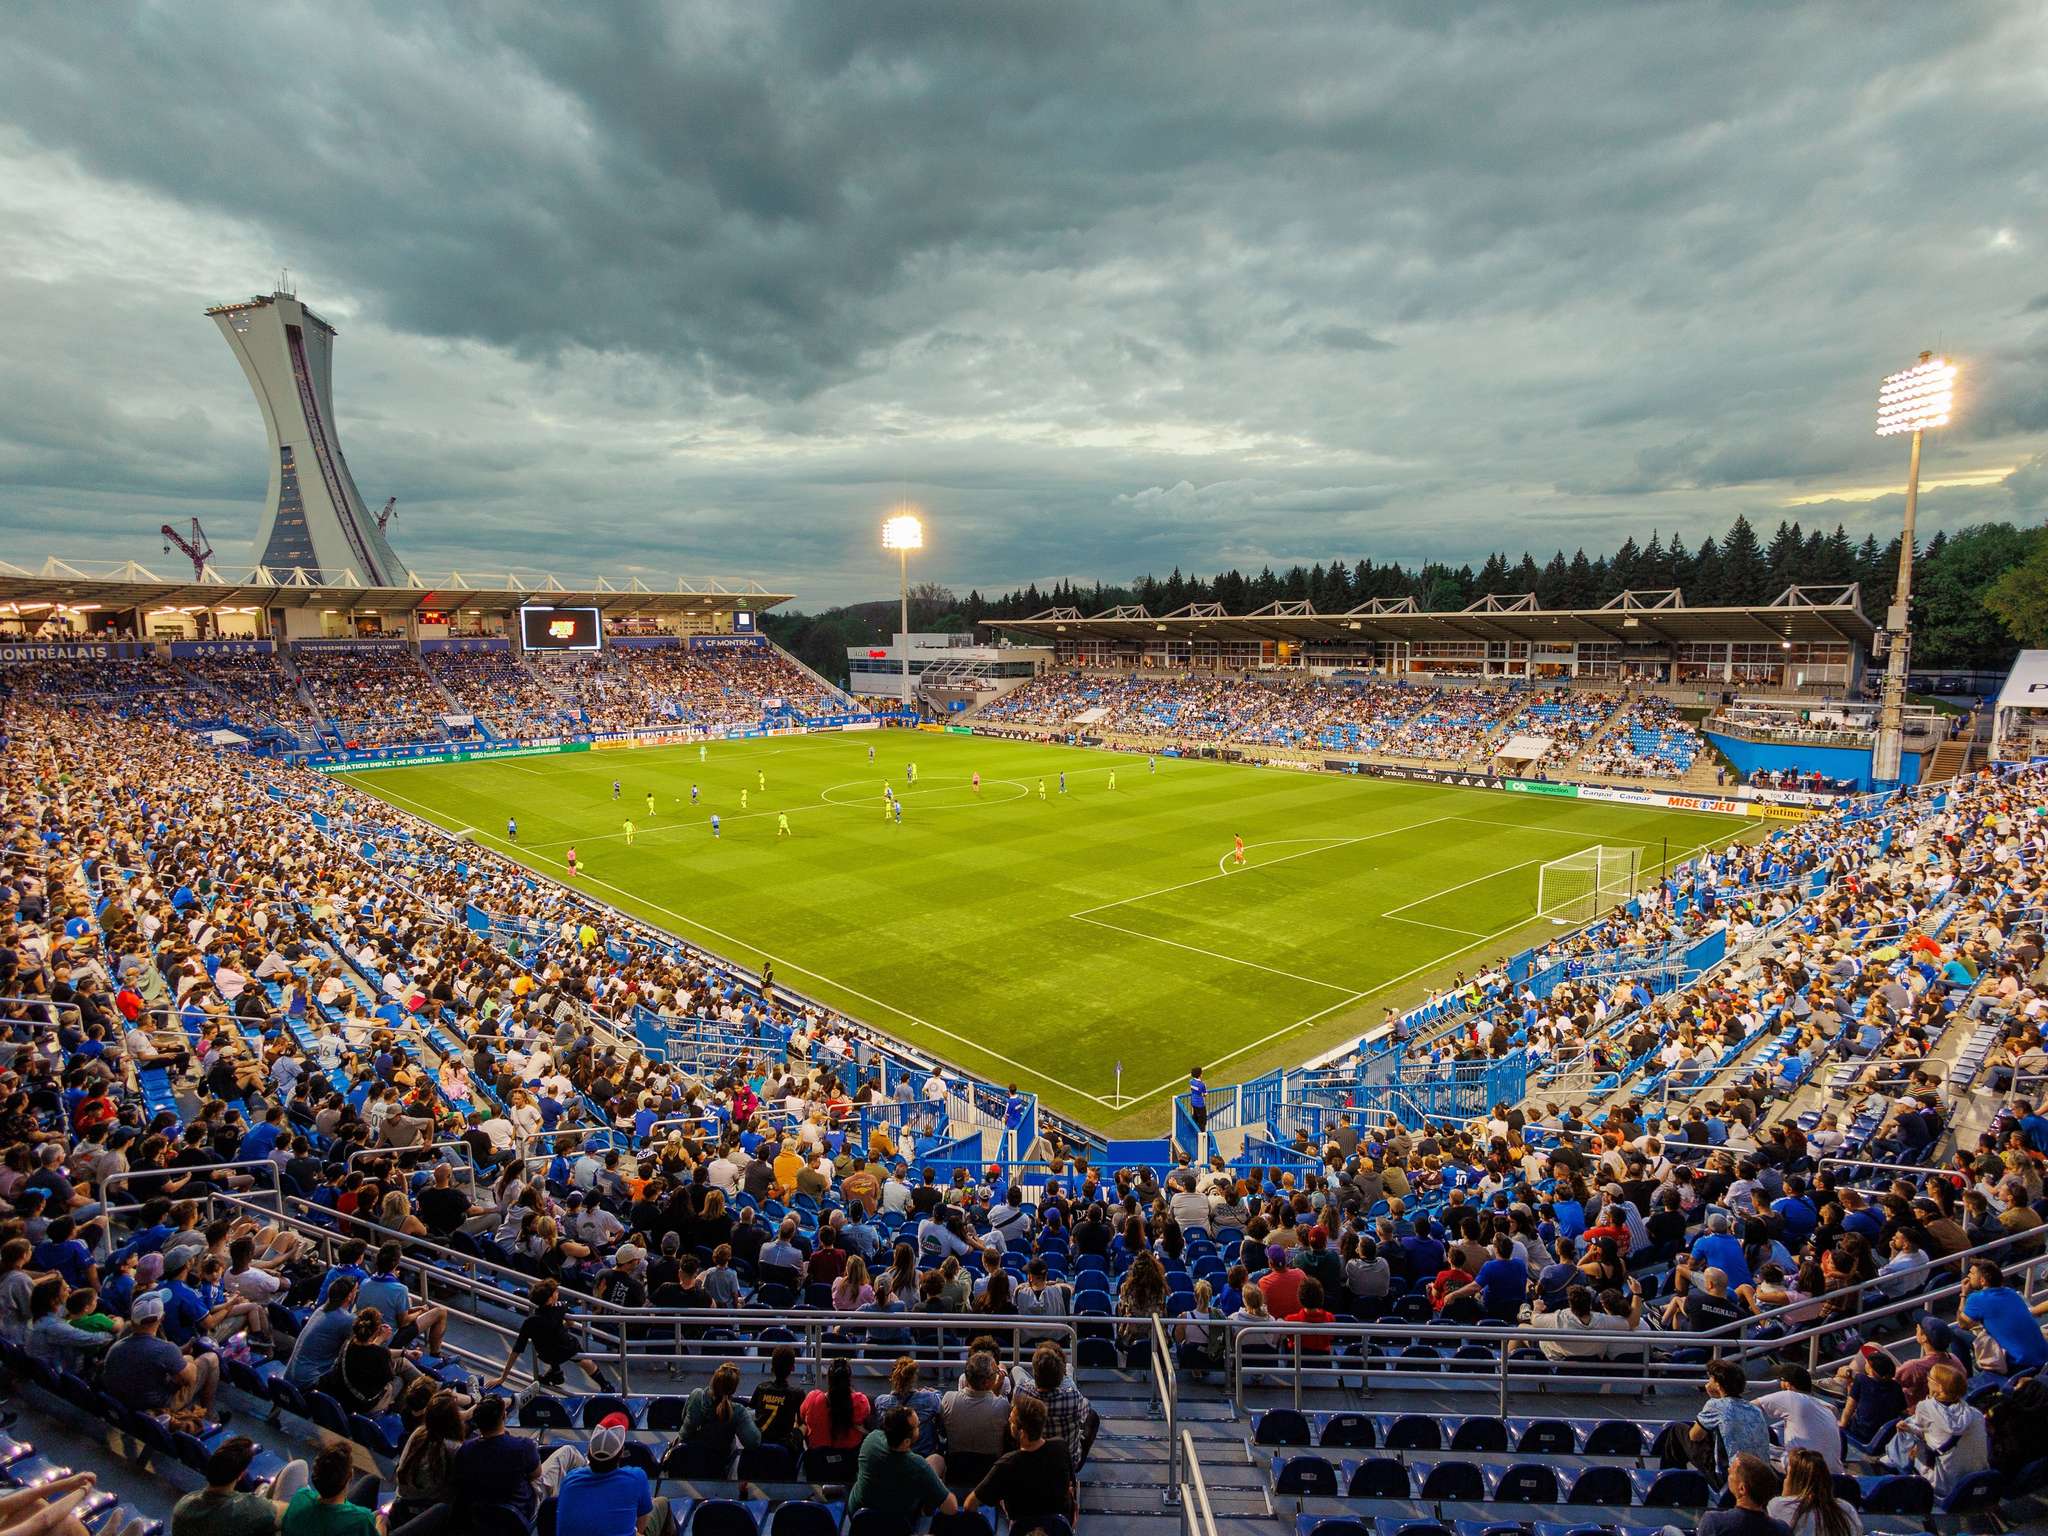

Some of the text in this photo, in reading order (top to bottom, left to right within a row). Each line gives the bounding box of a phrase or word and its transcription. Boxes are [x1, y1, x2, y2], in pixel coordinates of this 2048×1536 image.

[705, 638, 758, 647] CF MONTRÉAL
[0, 645, 107, 661] ONTRÉALAIS
[325, 763, 369, 772] FONDATION
[407, 757, 444, 765] MONTRÉAL
[1527, 784, 1569, 794] consignaction
[1583, 789, 1613, 798] Canpar
[1619, 793, 1651, 801] Canpar
[761, 1404, 779, 1432] 7
